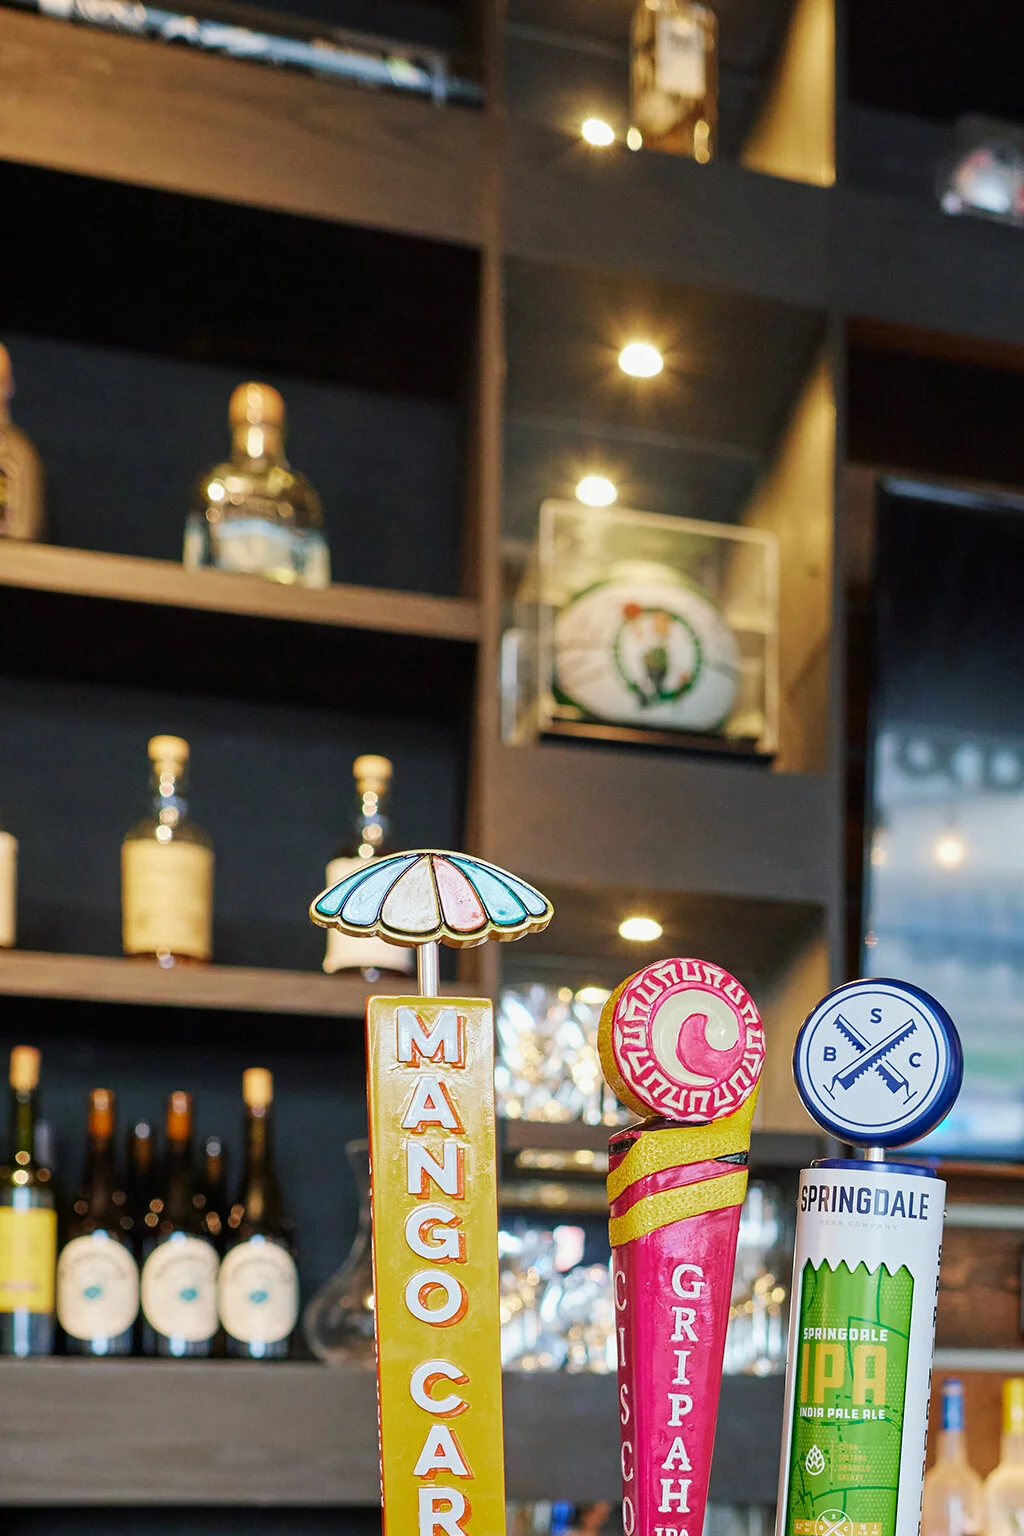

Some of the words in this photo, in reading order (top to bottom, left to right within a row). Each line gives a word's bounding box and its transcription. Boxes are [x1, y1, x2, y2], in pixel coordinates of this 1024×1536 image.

[869, 1008, 883, 1024] S
[823, 1046, 837, 1062] B
[908, 1052, 922, 1068] C
[396, 1008, 468, 1327] MANGO
[801, 1185, 930, 1220] SPRINGDALE
[803, 1327, 889, 1342] SPRINGDALE
[657, 1263, 706, 1513] GRIPAH
[800, 1343, 888, 1406] IPA
[613, 1269, 635, 1536] CISCO
[800, 1407, 825, 1418] INDIA
[827, 1408, 860, 1419] PALE
[863, 1409, 886, 1420] ALE
